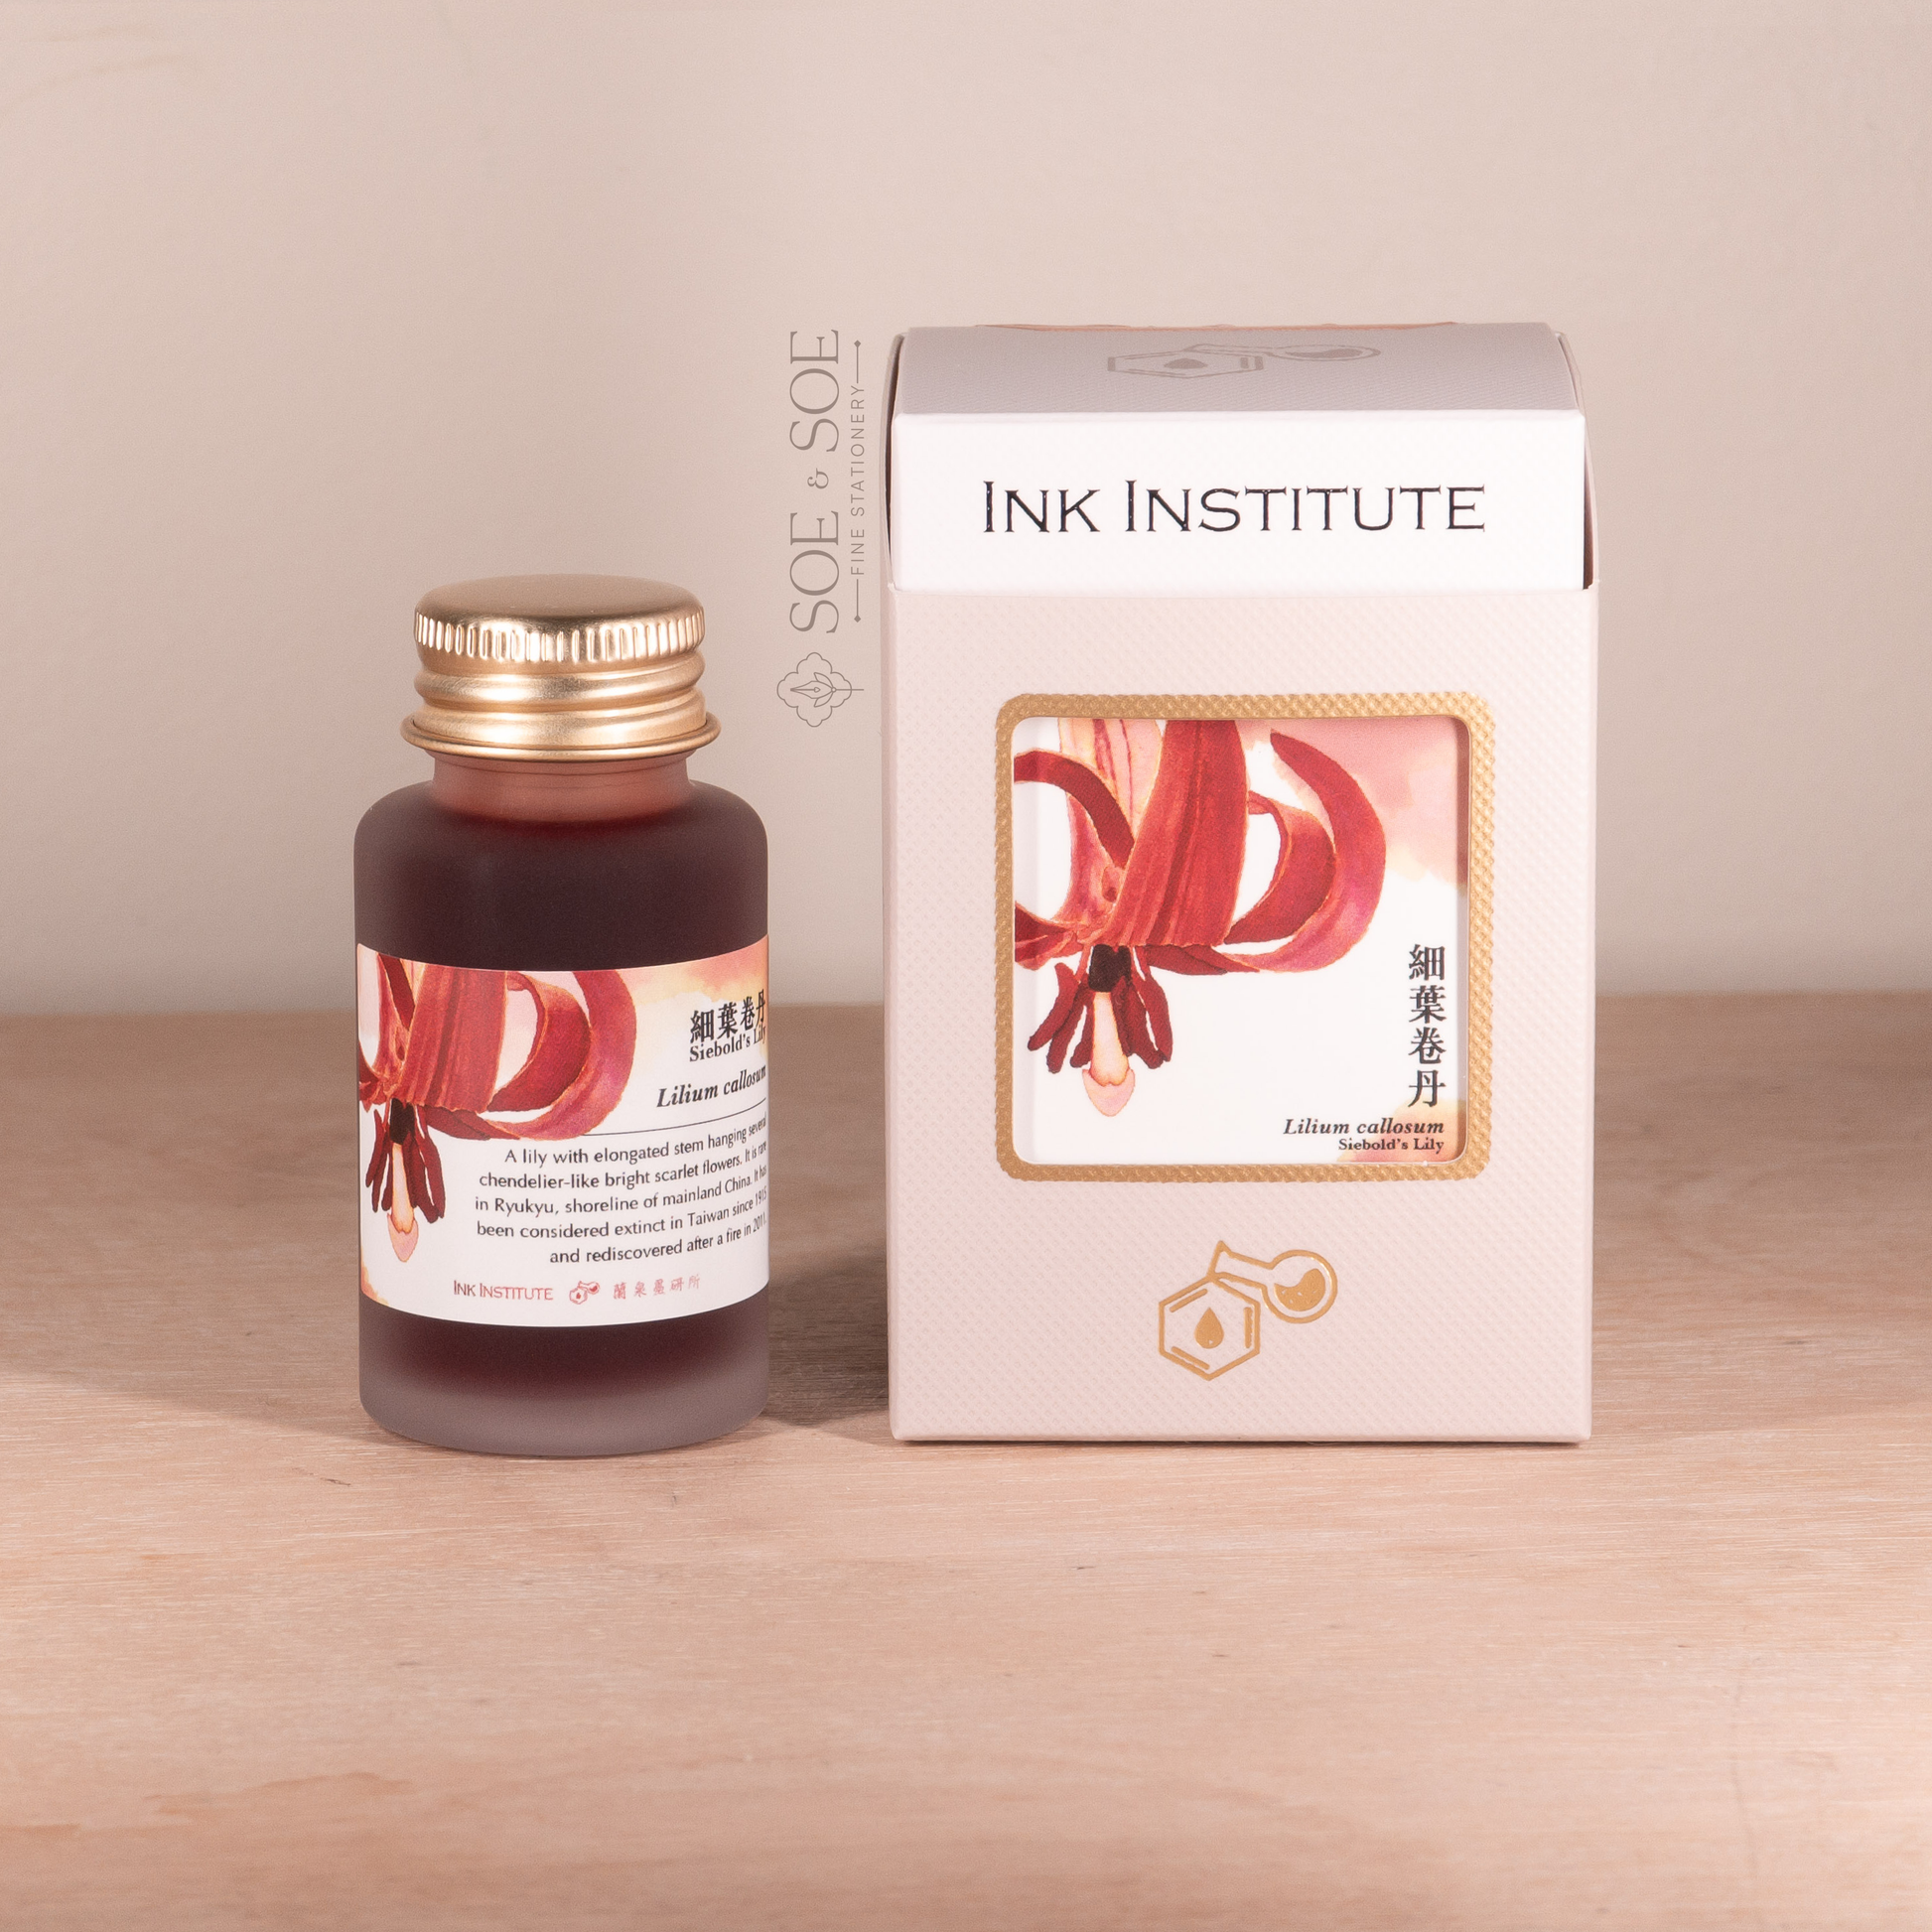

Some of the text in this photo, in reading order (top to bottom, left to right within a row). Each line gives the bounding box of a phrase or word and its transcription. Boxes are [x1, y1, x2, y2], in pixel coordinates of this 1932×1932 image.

[690, 989, 766, 1044] 細葉卷丹
[1408, 943, 1448, 1109] 細葉卷丹
[689, 1024, 766, 1062] Siebold's Lily
[656, 1064, 766, 1108] Lilium callosum
[504, 1111, 767, 1169] A lily with elongated stem hanging several
[1283, 1117, 1445, 1135] Lilium callosum
[1338, 1138, 1445, 1155] Siebold's Lily
[479, 1140, 767, 1190] chendelier-like bright scarlet flowers. It is rare
[475, 1164, 767, 1218] in Ryukyu, shoreline of mainland China. It has
[477, 1185, 767, 1239] been considered extinct in Taiwan since 1915
[549, 1248, 580, 1263] and
[586, 1238, 683, 1263] rediscovered
[686, 1236, 714, 1253] after
[717, 1234, 724, 1245] a
[726, 1227, 742, 1243] fire
[744, 1223, 752, 1237] in
